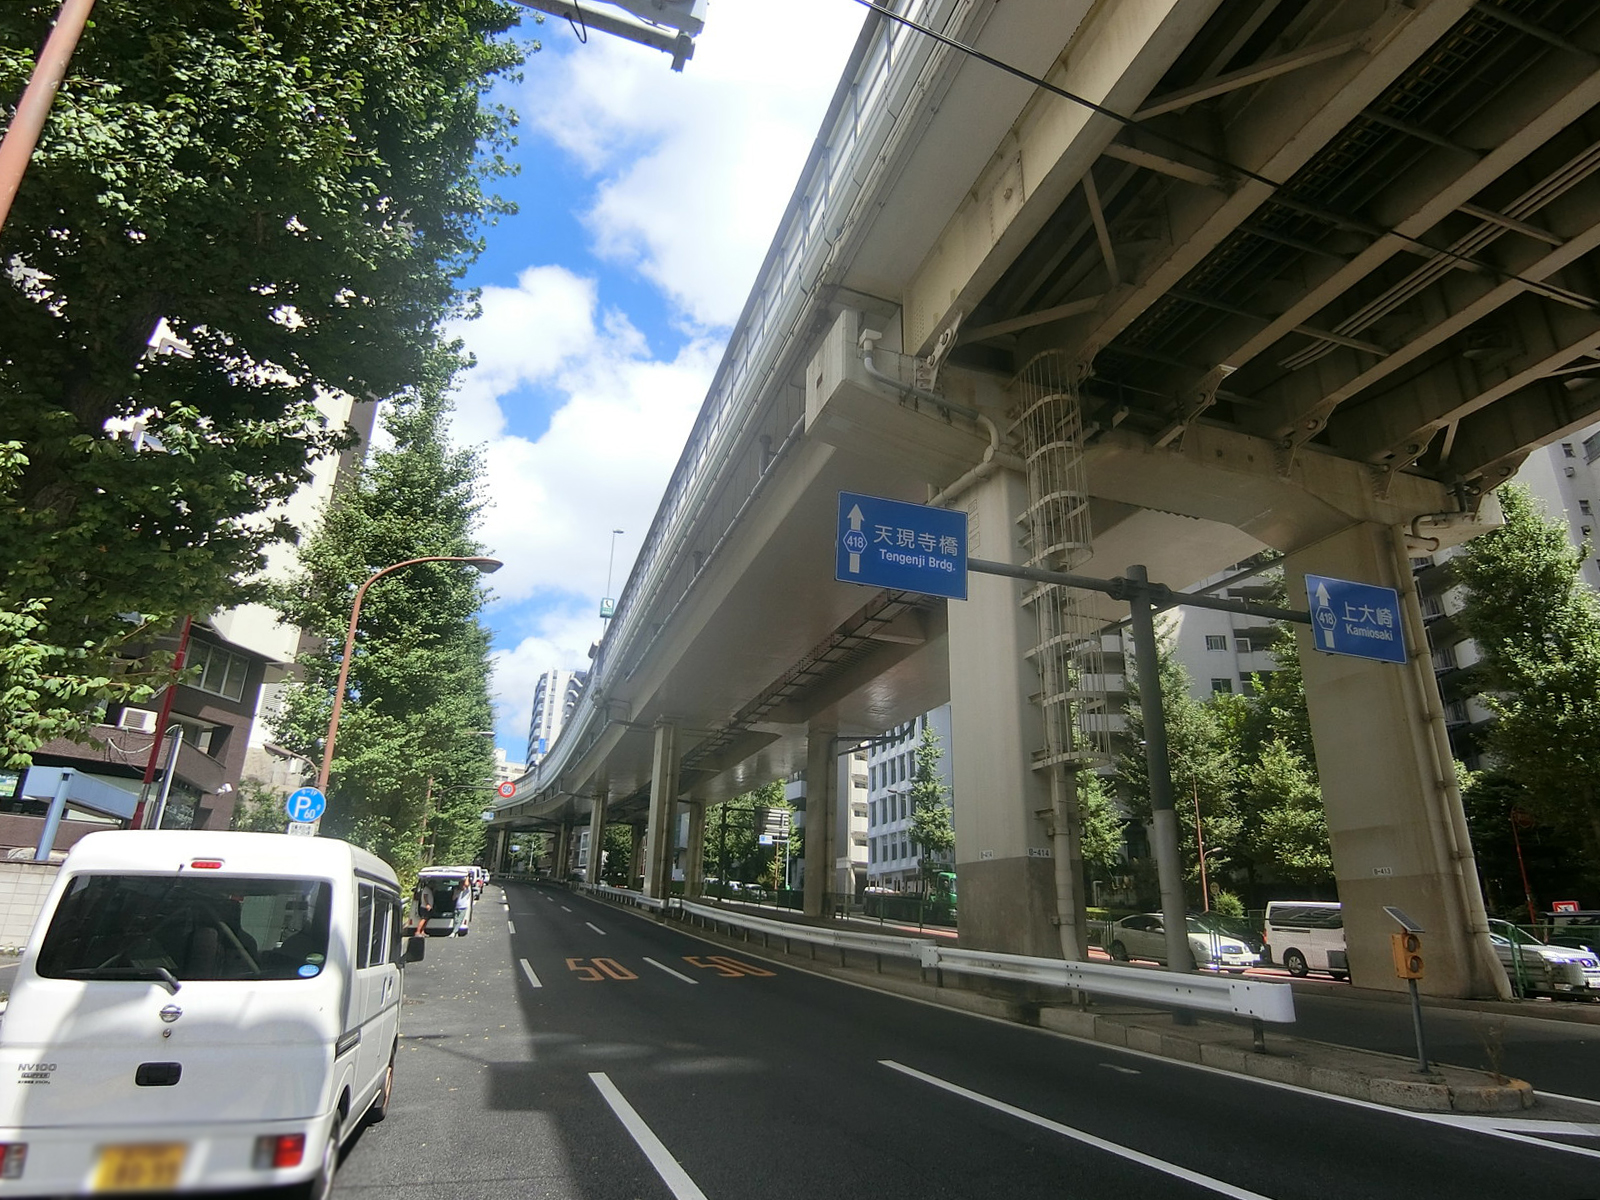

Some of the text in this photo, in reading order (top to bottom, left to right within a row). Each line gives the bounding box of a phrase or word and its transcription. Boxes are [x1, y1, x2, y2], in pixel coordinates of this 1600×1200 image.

[847, 536, 864, 549] 418
[874, 525, 958, 557] 天現寺橋
[880, 549, 956, 573] Tengenji Brdg.
[1320, 612, 1333, 625] 418
[1342, 601, 1393, 628] 上大崎
[1345, 623, 1393, 641] Kamiosaki
[502, 785, 511, 794] 50
[294, 796, 312, 818] P
[565, 957, 639, 981] 50
[681, 956, 778, 977] 50
[18, 1063, 58, 1071] NV100
